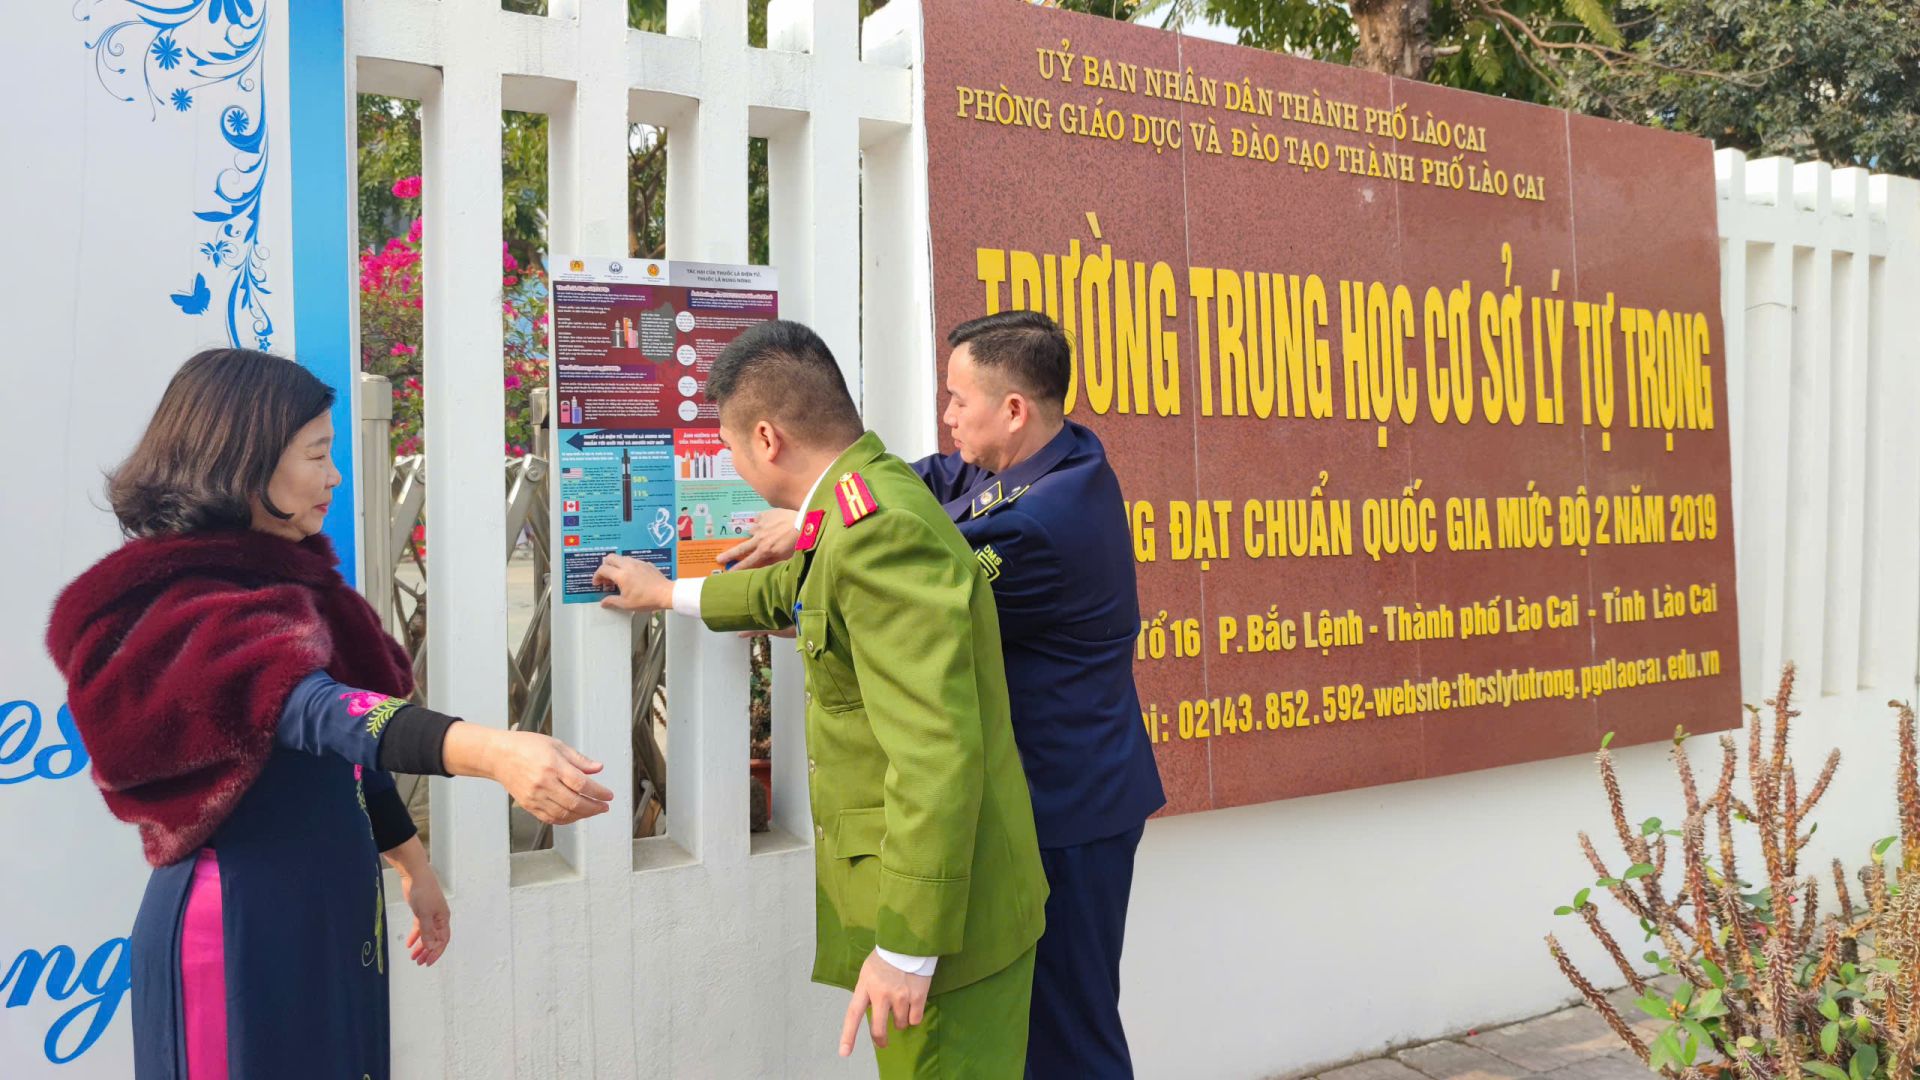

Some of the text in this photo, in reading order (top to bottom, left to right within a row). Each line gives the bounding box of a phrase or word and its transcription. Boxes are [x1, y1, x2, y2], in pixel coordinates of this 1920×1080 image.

[957, 84, 1546, 201] PHÒNG GIÁO DỤC VÀ ĐÀO TẠO THÀNH PHỐ LÀO CAI
[1083, 56, 1137, 93] BAN
[1145, 67, 1217, 107] NHÂN
[1225, 78, 1273, 116] DÂN
[1278, 90, 1359, 132] THÀNH
[1364, 103, 1408, 140] PHỐ
[1411, 113, 1451, 148] LÀO
[1454, 123, 1487, 153] CAI
[1189, 267, 1333, 419] TRUNG
[1339, 280, 1418, 448] HỌC
[1424, 280, 1474, 425] CƠ
[1479, 242, 1526, 425] SỞ
[1531, 269, 1565, 425] LÝ
[1573, 292, 1614, 452] TỰ
[1620, 307, 1714, 452] TRỌNG
[983, 544, 1003, 566] DMS
[1169, 500, 1232, 571] ĐẠT
[1244, 470, 1353, 559] CHUẨN
[1362, 478, 1437, 562] QUỐC
[1446, 497, 1492, 551] GIA
[1497, 480, 1553, 549] MỨC
[1559, 485, 1591, 556] ĐỘ
[1596, 495, 1610, 545] 2
[1613, 484, 1665, 545] NĂM
[1670, 493, 1717, 542] 2019
[1137, 610, 1166, 660] Tổ
[1170, 618, 1201, 658] 16
[1303, 609, 1364, 656] Lệnh
[1383, 602, 1454, 642] Thành
[1460, 595, 1501, 640] phố
[1506, 596, 1542, 634] Lào
[1546, 594, 1579, 629] Cai
[1602, 586, 1646, 624] Tỉnh
[1653, 584, 1685, 620] Lào
[1689, 582, 1718, 615] Cai
[0, 936, 131, 1064] ng
